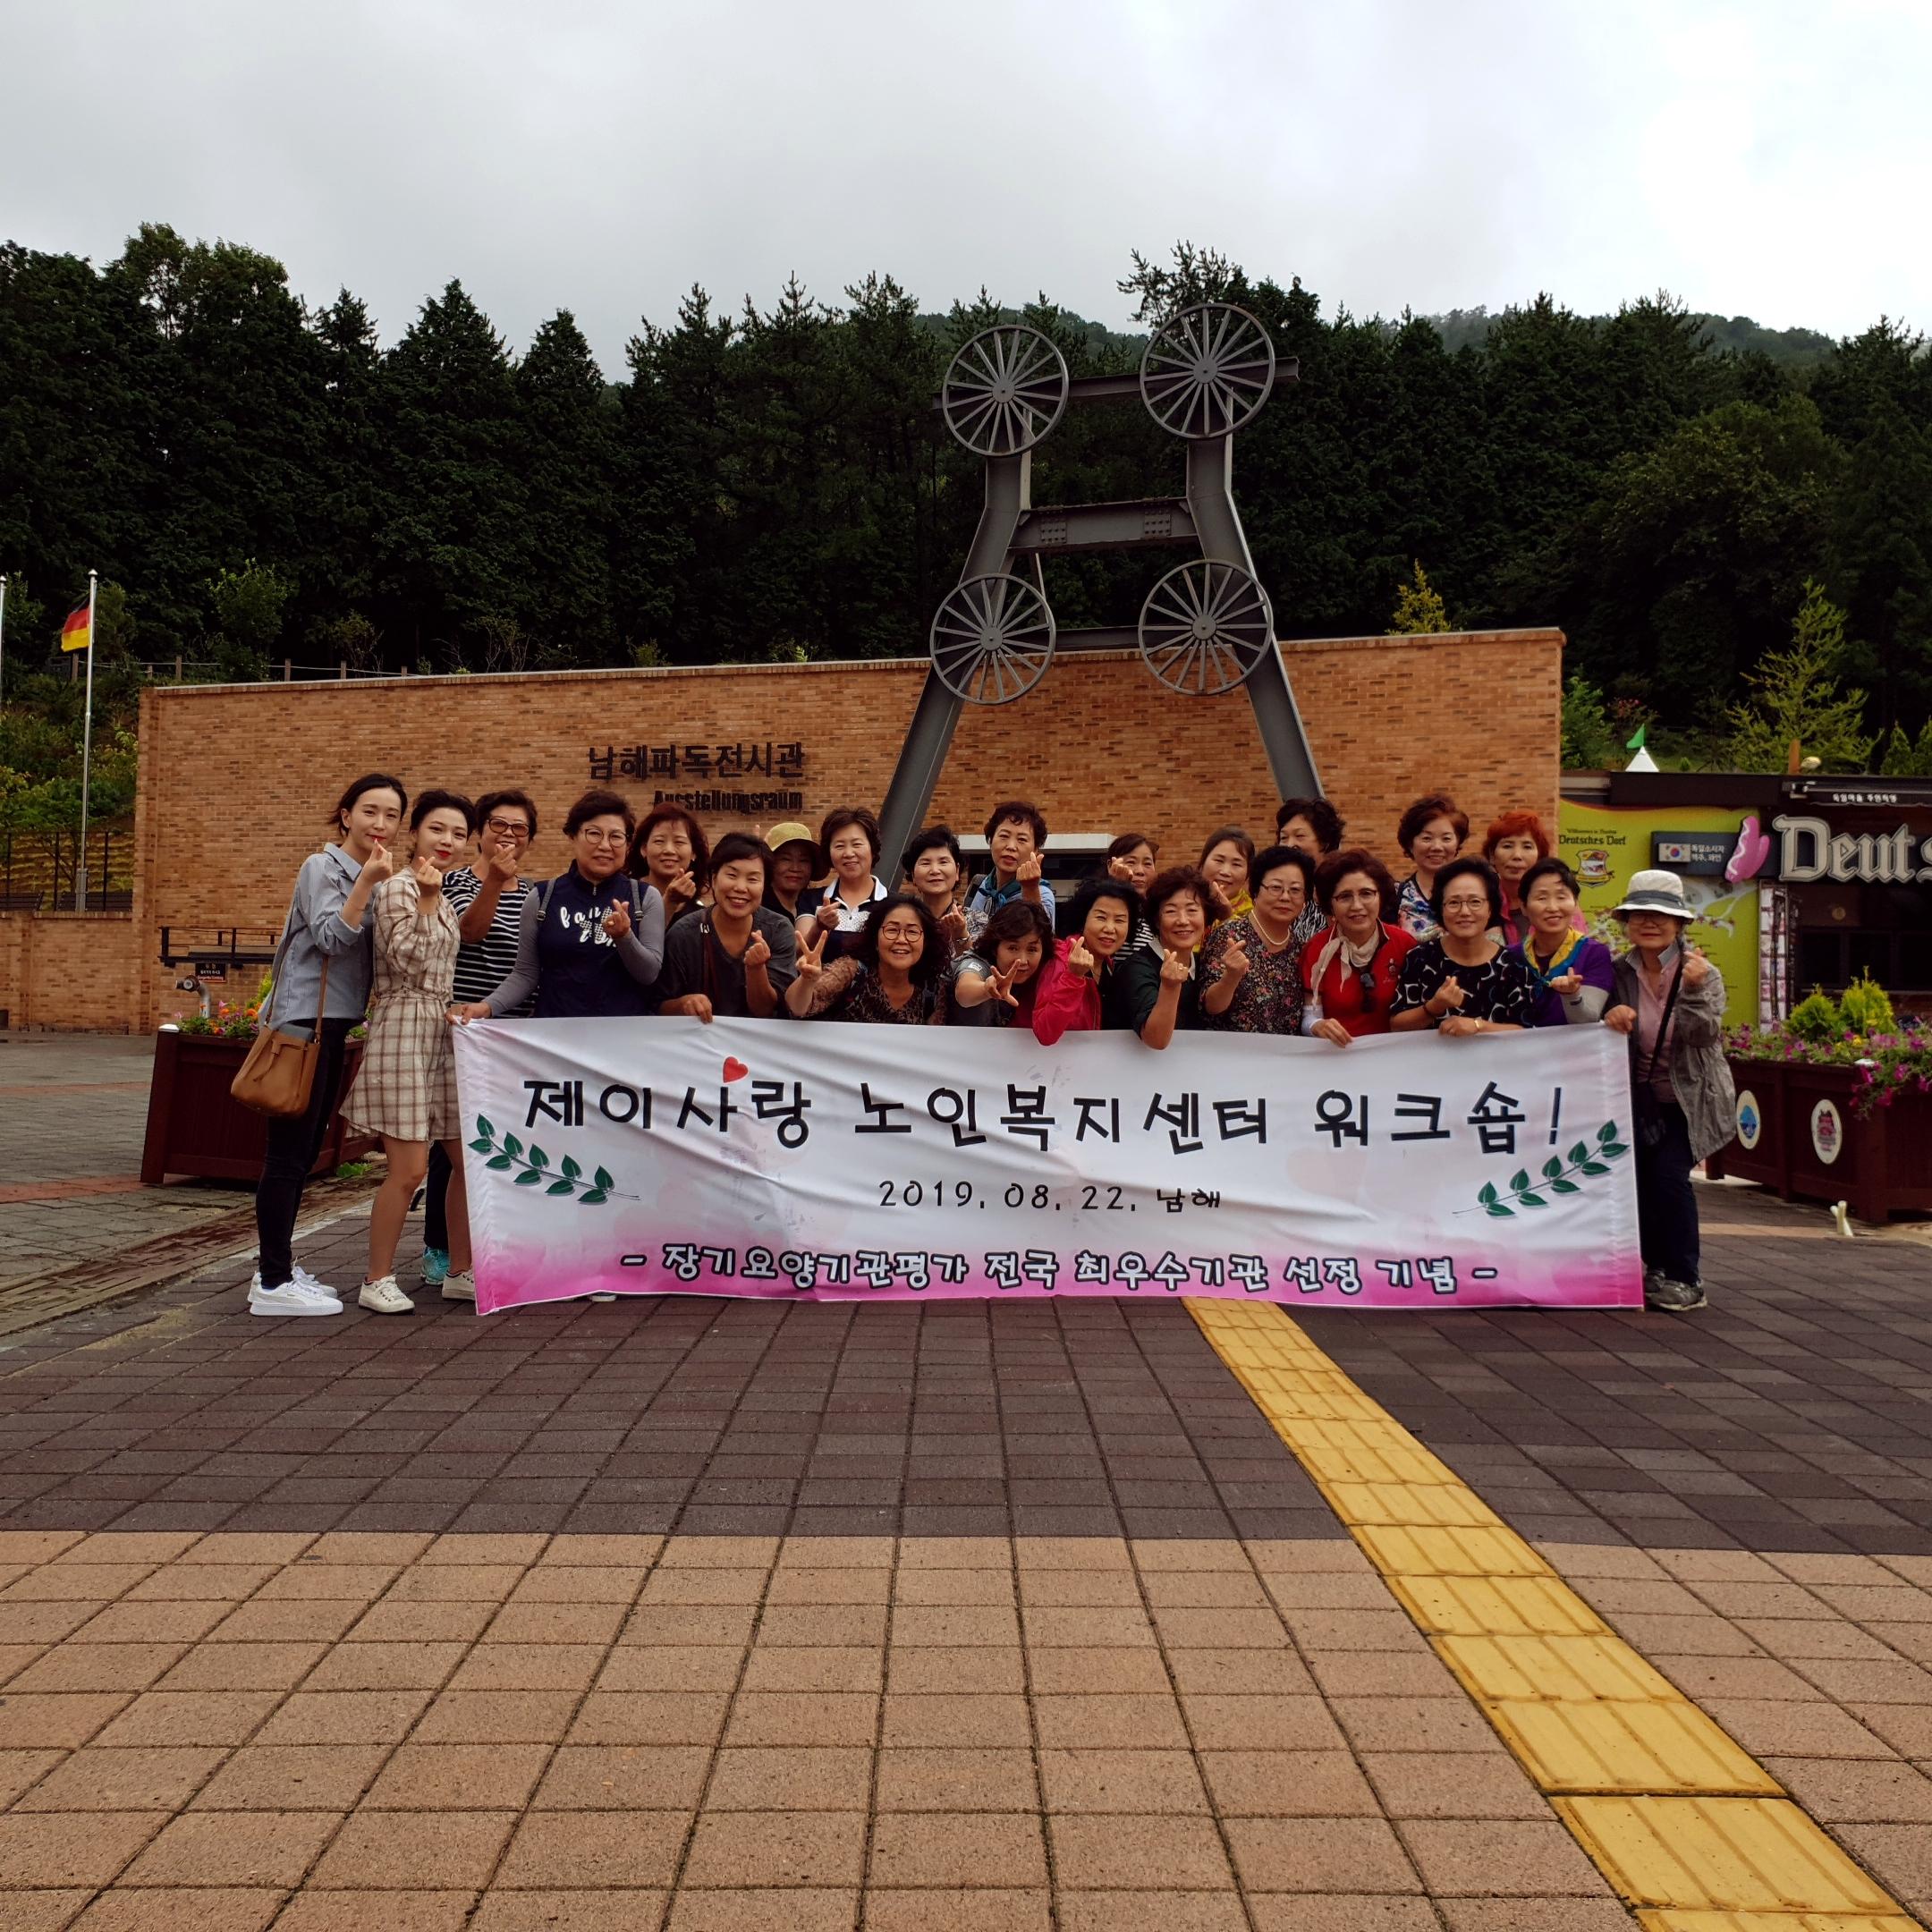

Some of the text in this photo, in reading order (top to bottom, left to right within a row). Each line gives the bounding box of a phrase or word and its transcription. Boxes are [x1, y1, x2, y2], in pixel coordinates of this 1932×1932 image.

[589, 741, 805, 781] 남해파독전시관
[524, 1080, 1562, 1155] 제이사랑 노인복지센터 워크숍!
[878, 1180, 1221, 1213] 2019. 08. 22. 남해
[662, 1242, 970, 1290] 장기요양기관평가
[984, 1249, 1060, 1291] 전국
[1074, 1250, 1269, 1292] 최우수기관
[1284, 1256, 1363, 1295] 선정
[1375, 1255, 1457, 1294] 기념
